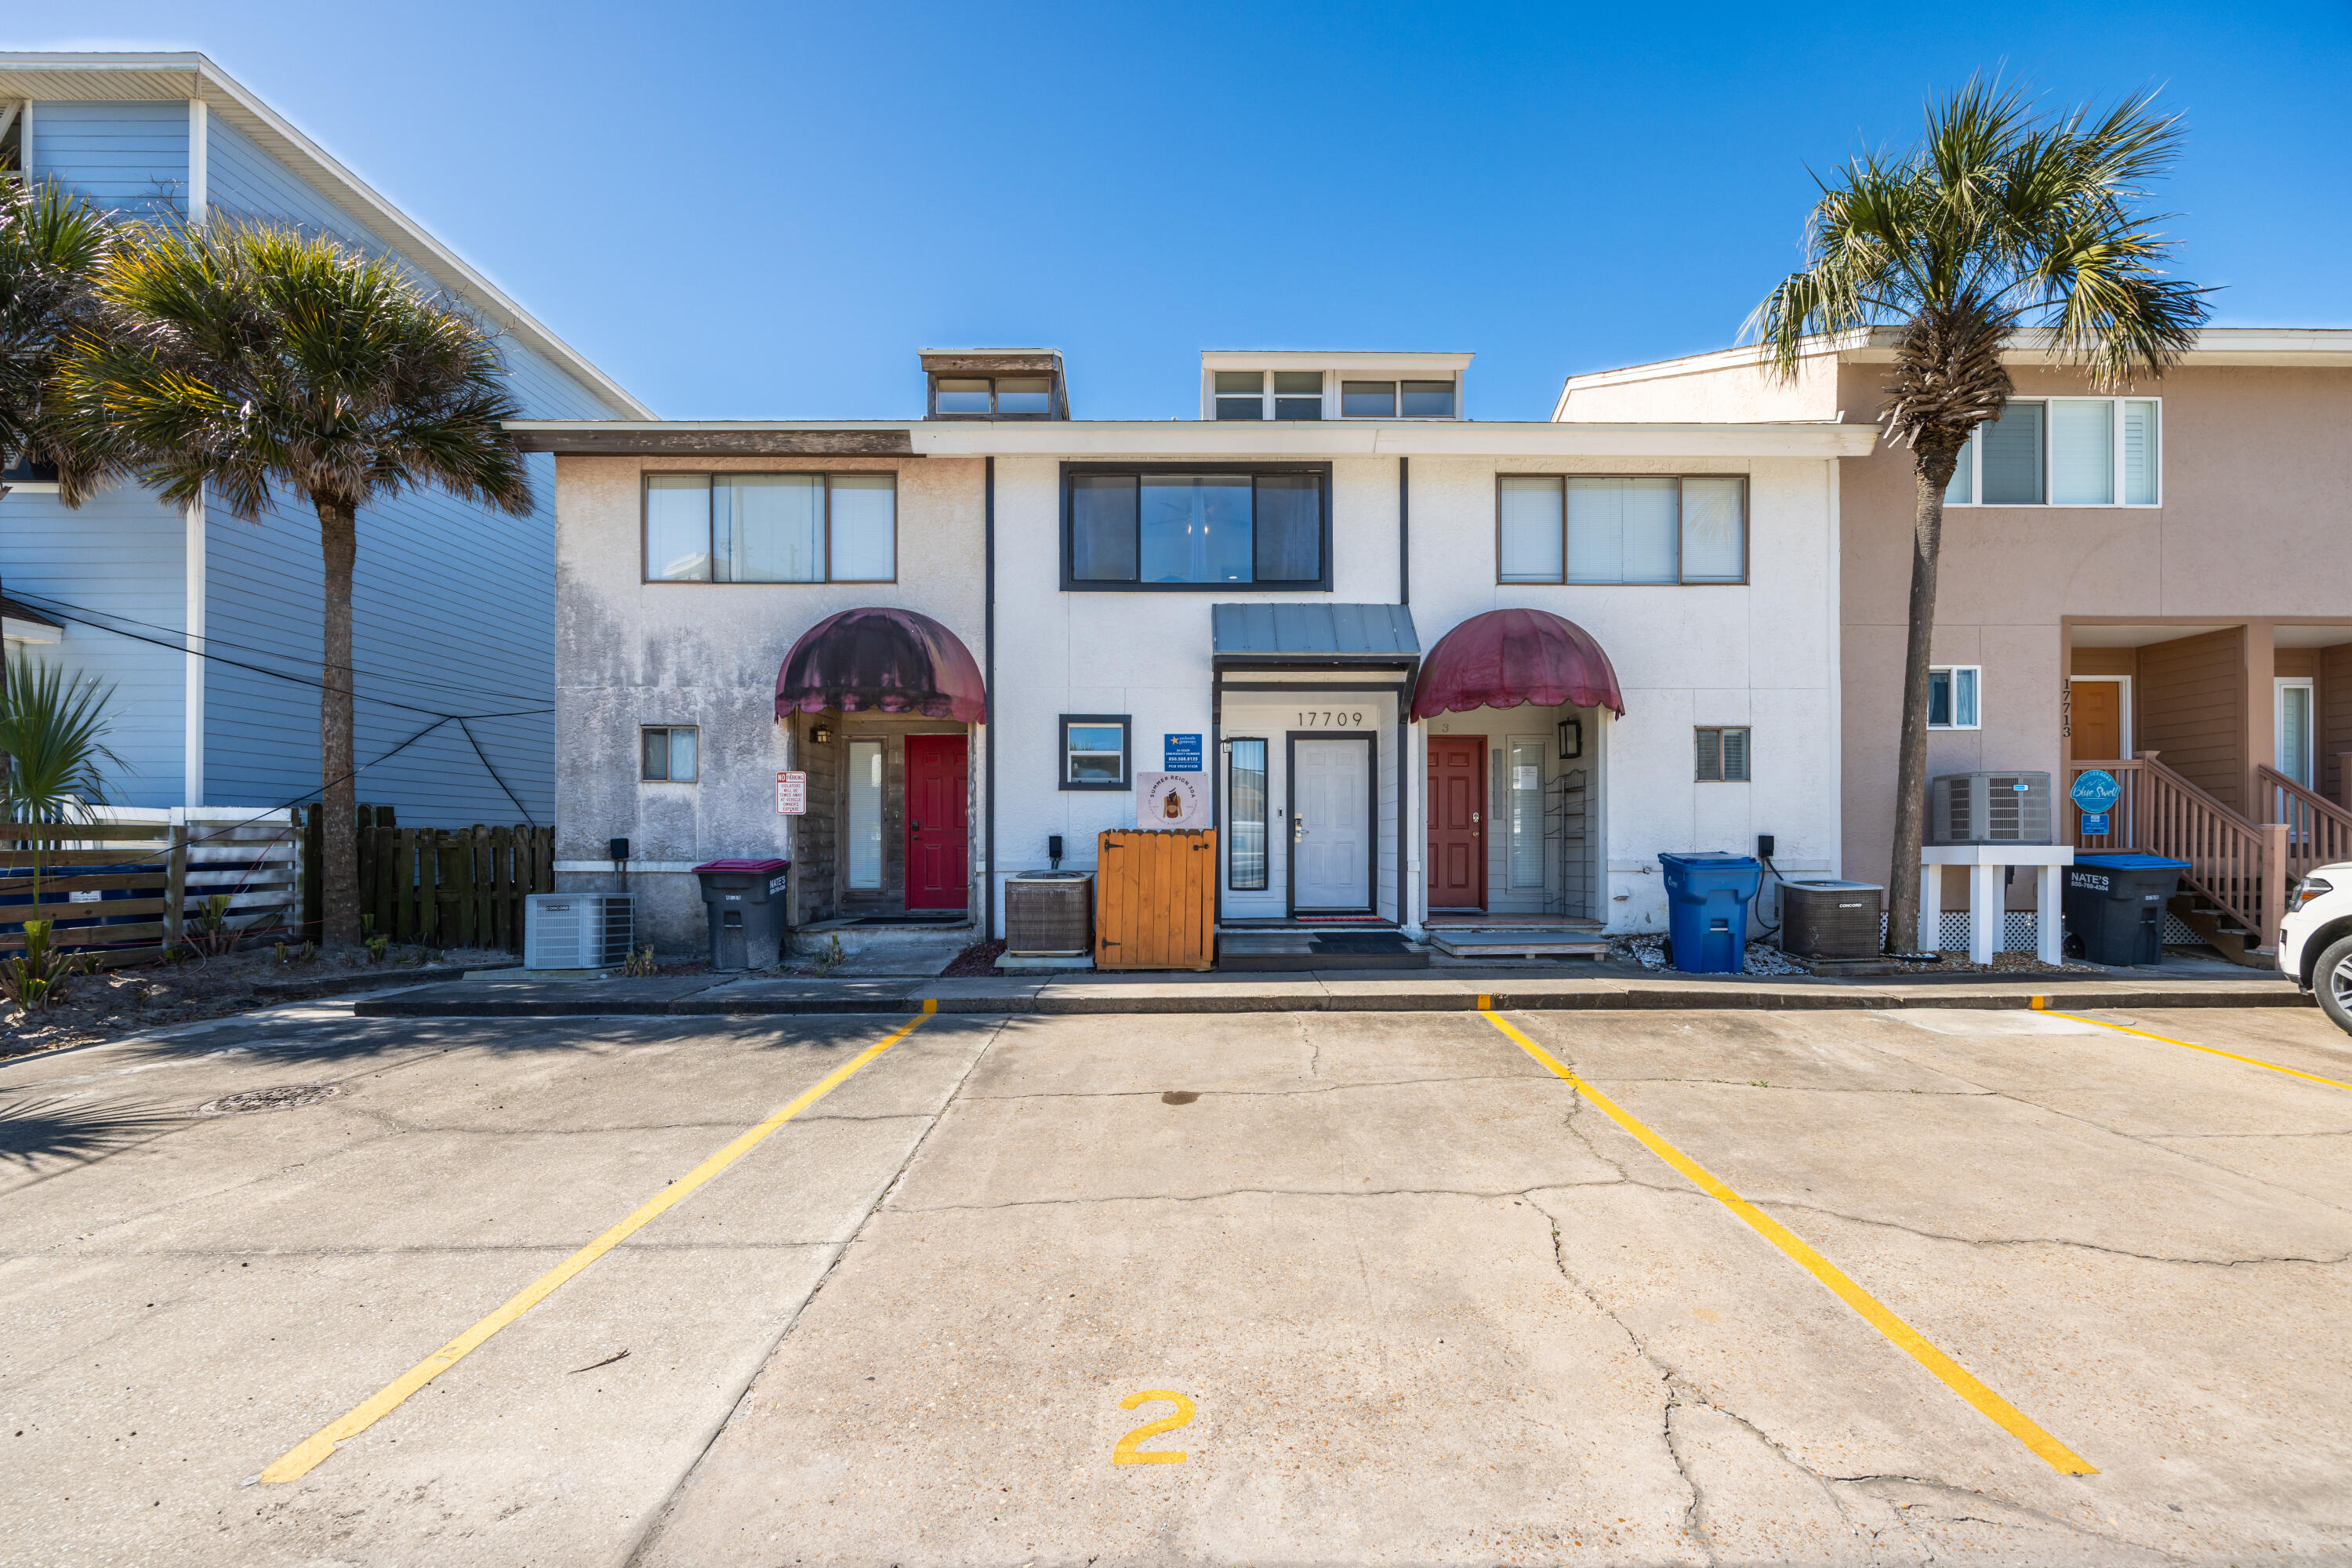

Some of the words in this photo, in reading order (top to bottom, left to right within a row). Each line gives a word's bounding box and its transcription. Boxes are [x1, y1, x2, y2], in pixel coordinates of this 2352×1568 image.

[1298, 712, 1362, 726] 17709
[1443, 723, 1449, 733] 3
[1150, 776, 1169, 797] SUMMER
[1171, 775, 1189, 786] REIGN
[2072, 786, 2093, 797] Blue
[2095, 786, 2119, 798] Swell
[770, 875, 786, 888] NATE'S
[2071, 872, 2109, 885] NATE'S
[1112, 1389, 1196, 1465] 2
